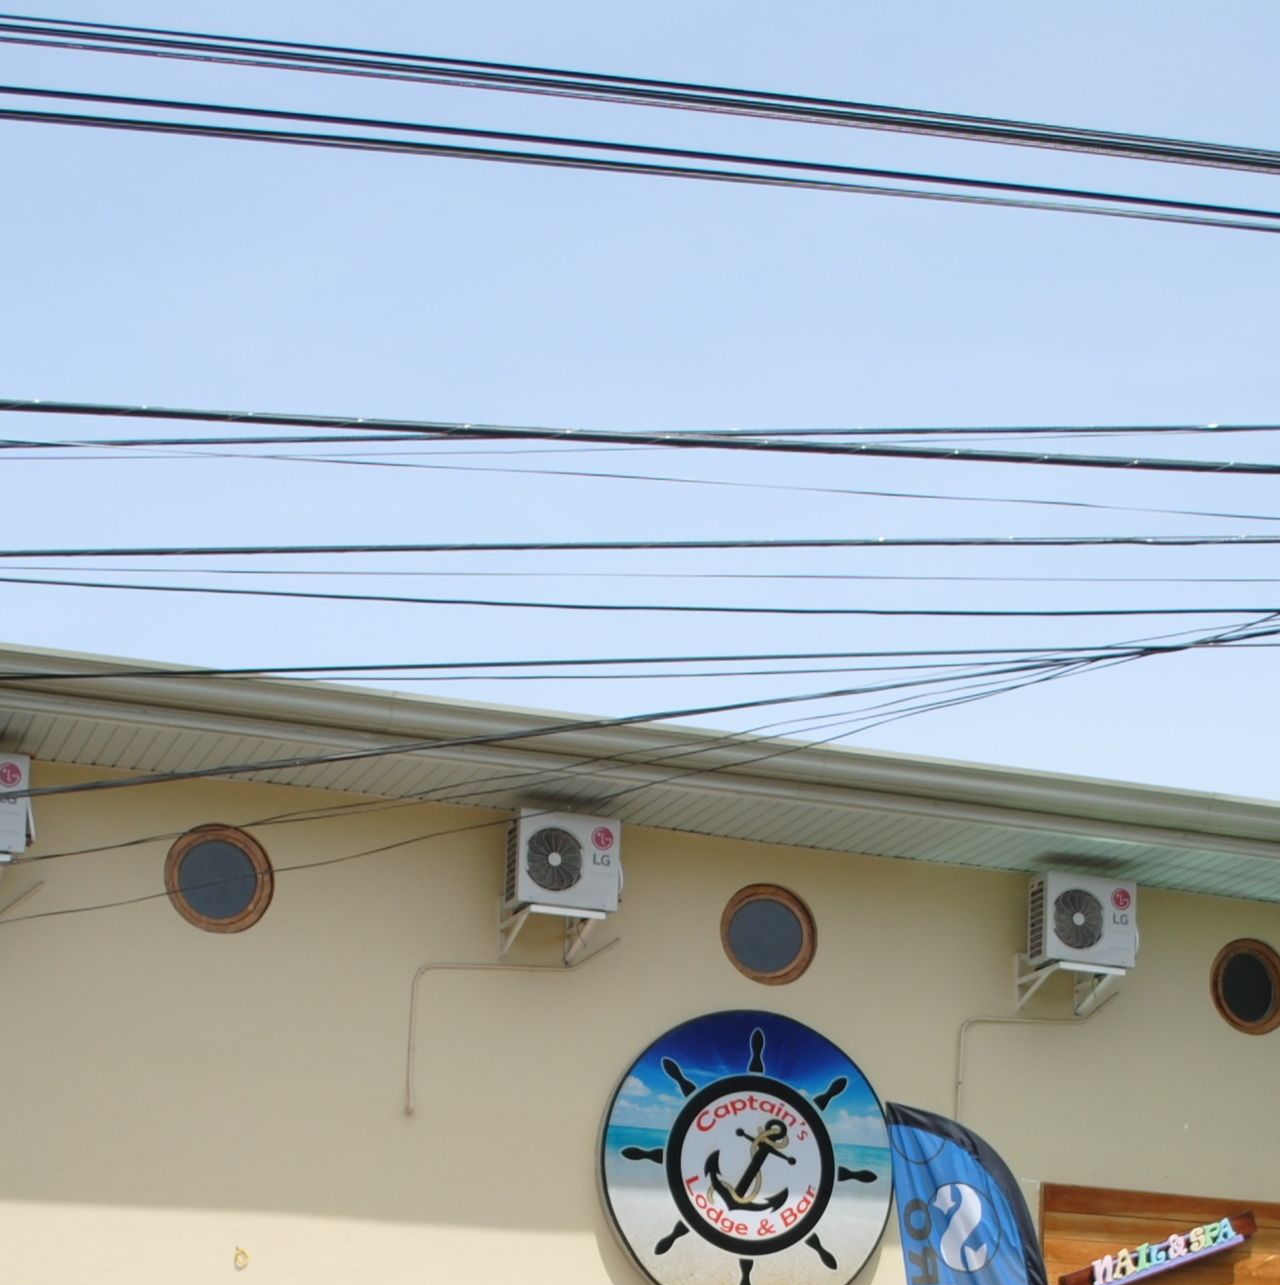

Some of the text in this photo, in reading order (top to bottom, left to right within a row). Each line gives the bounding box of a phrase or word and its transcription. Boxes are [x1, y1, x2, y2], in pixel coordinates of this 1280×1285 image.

[592, 853, 611, 867] LG
[1111, 913, 1129, 925] LG
[695, 1094, 808, 1141] Captain's
[685, 1174, 817, 1236] Lodge & Bar
[1167, 1233, 1188, 1259] &
[1189, 1217, 1236, 1253] SPA
